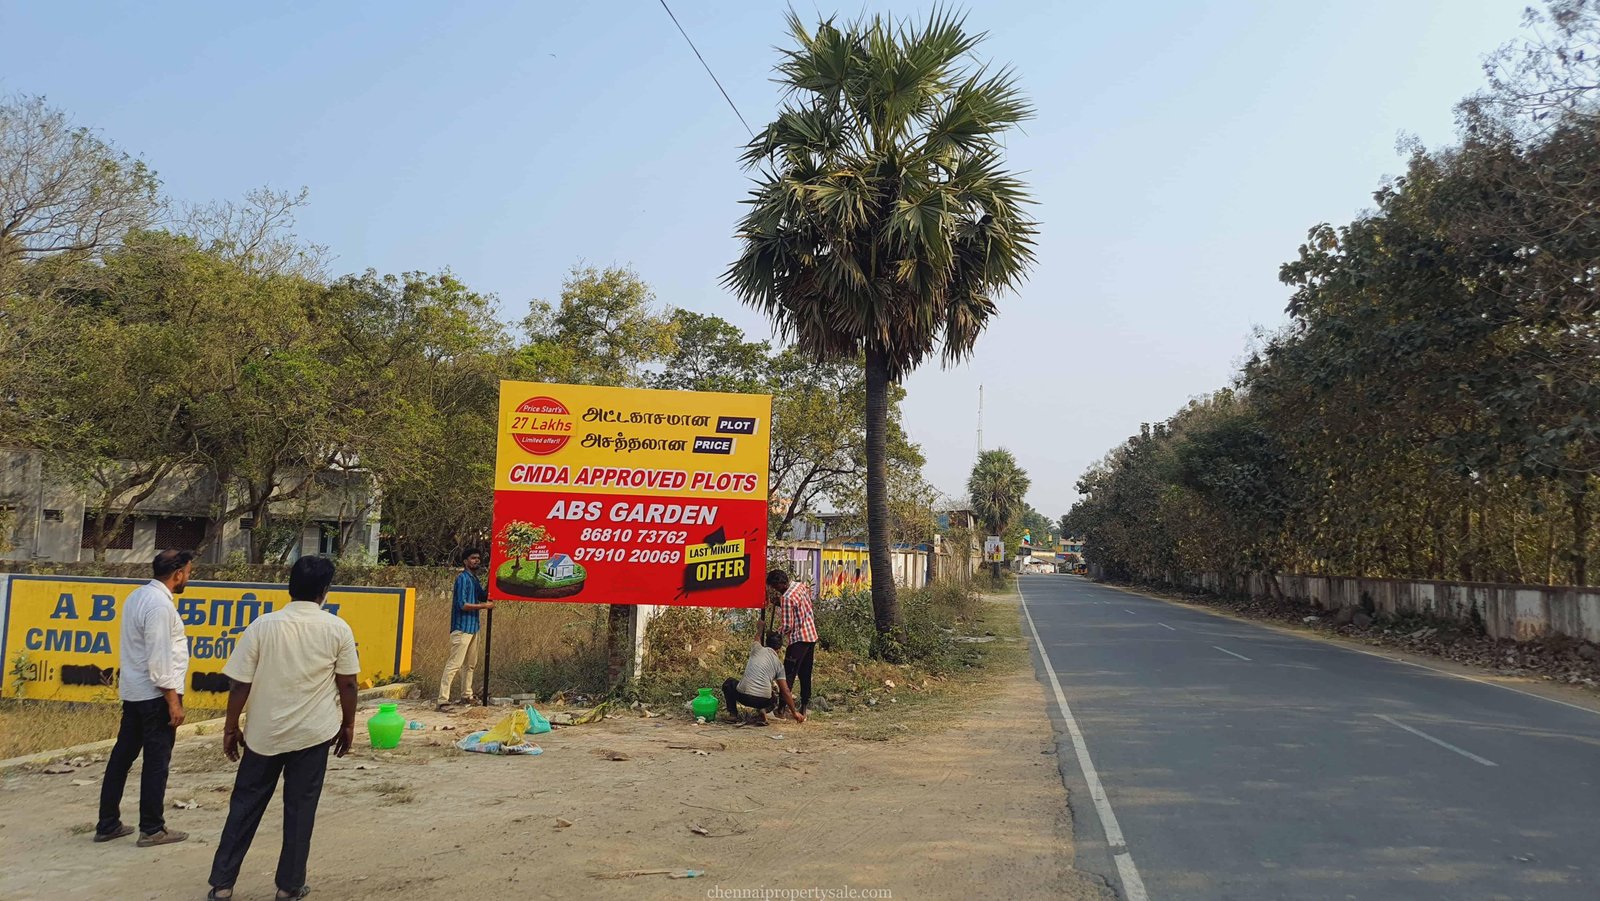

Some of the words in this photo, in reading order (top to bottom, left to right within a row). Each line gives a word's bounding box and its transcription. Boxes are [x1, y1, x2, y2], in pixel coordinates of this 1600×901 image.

[522, 404, 540, 413] Price
[511, 416, 530, 430] 27
[531, 417, 573, 432] Lakhs
[581, 407, 711, 428] அட்டகாசமான
[719, 420, 751, 431] PLOT
[521, 436, 543, 444] Limited
[580, 432, 688, 453] அசத்தலான
[694, 440, 731, 451] PRICE
[509, 464, 569, 485] CMDA
[573, 466, 687, 490] APPROVED
[690, 472, 758, 492] PLOTS
[546, 500, 603, 522] ABS
[609, 502, 718, 525] GARDEN
[580, 528, 632, 543] 86810
[636, 529, 688, 545] 73762
[573, 548, 625, 563] 97910
[628, 549, 681, 564] 20069
[689, 548, 709, 558] LAST
[710, 543, 740, 556] MINUTE
[696, 560, 745, 582] OFFER
[25, 628, 113, 654] CMDA
